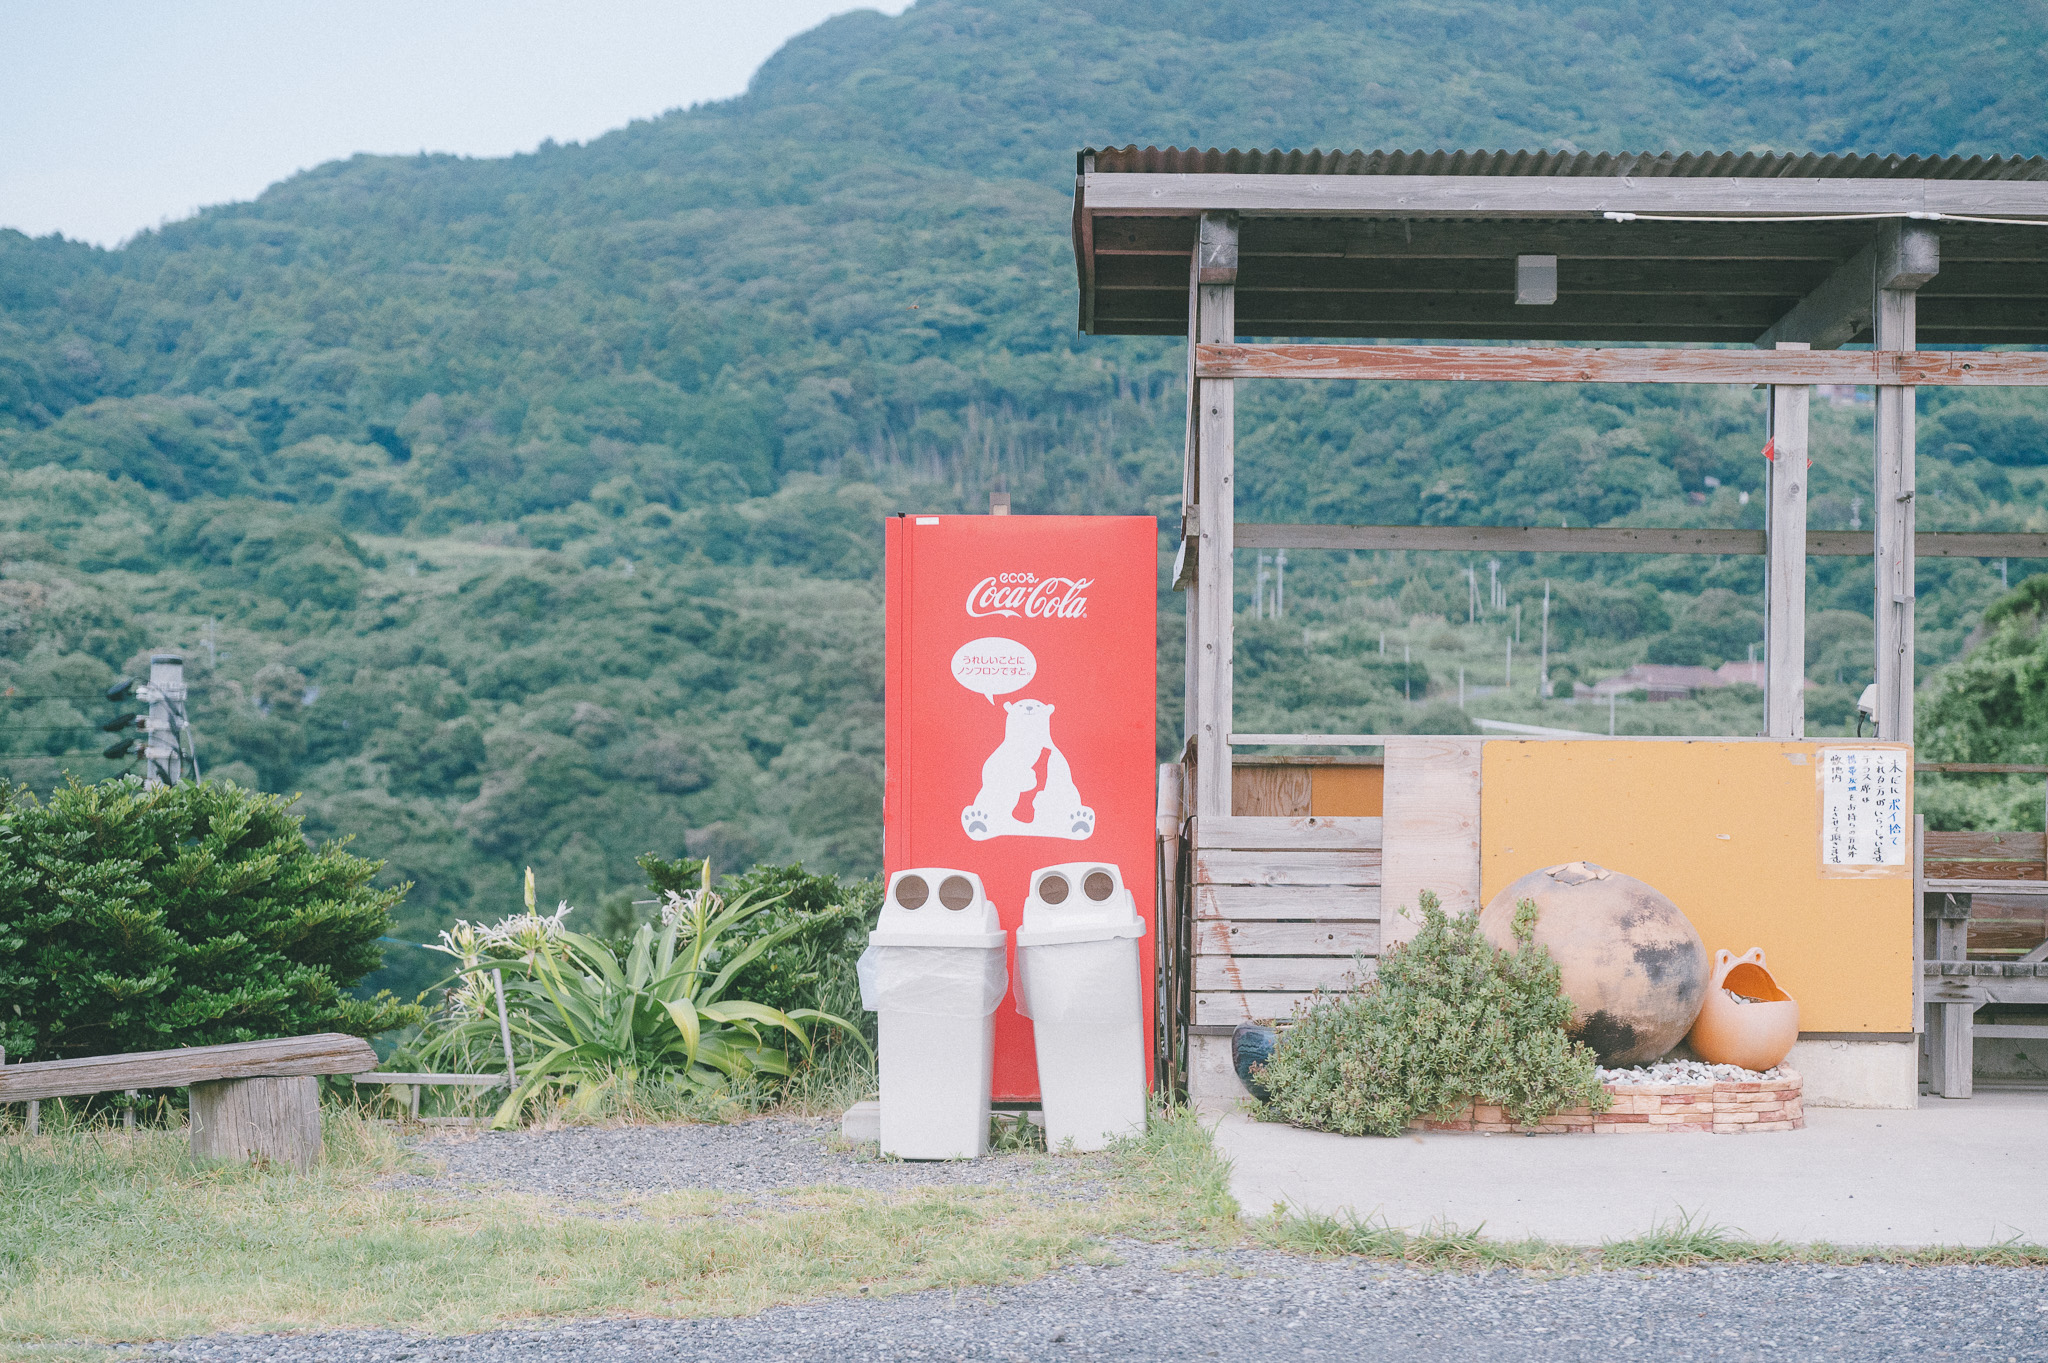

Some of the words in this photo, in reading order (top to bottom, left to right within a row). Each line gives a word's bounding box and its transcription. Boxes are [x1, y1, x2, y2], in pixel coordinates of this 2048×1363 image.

[966, 576, 1095, 618] Coca-Cola
[962, 655, 1026, 665] うれしいことに
[957, 667, 1031, 676] ノンフロンですと。
